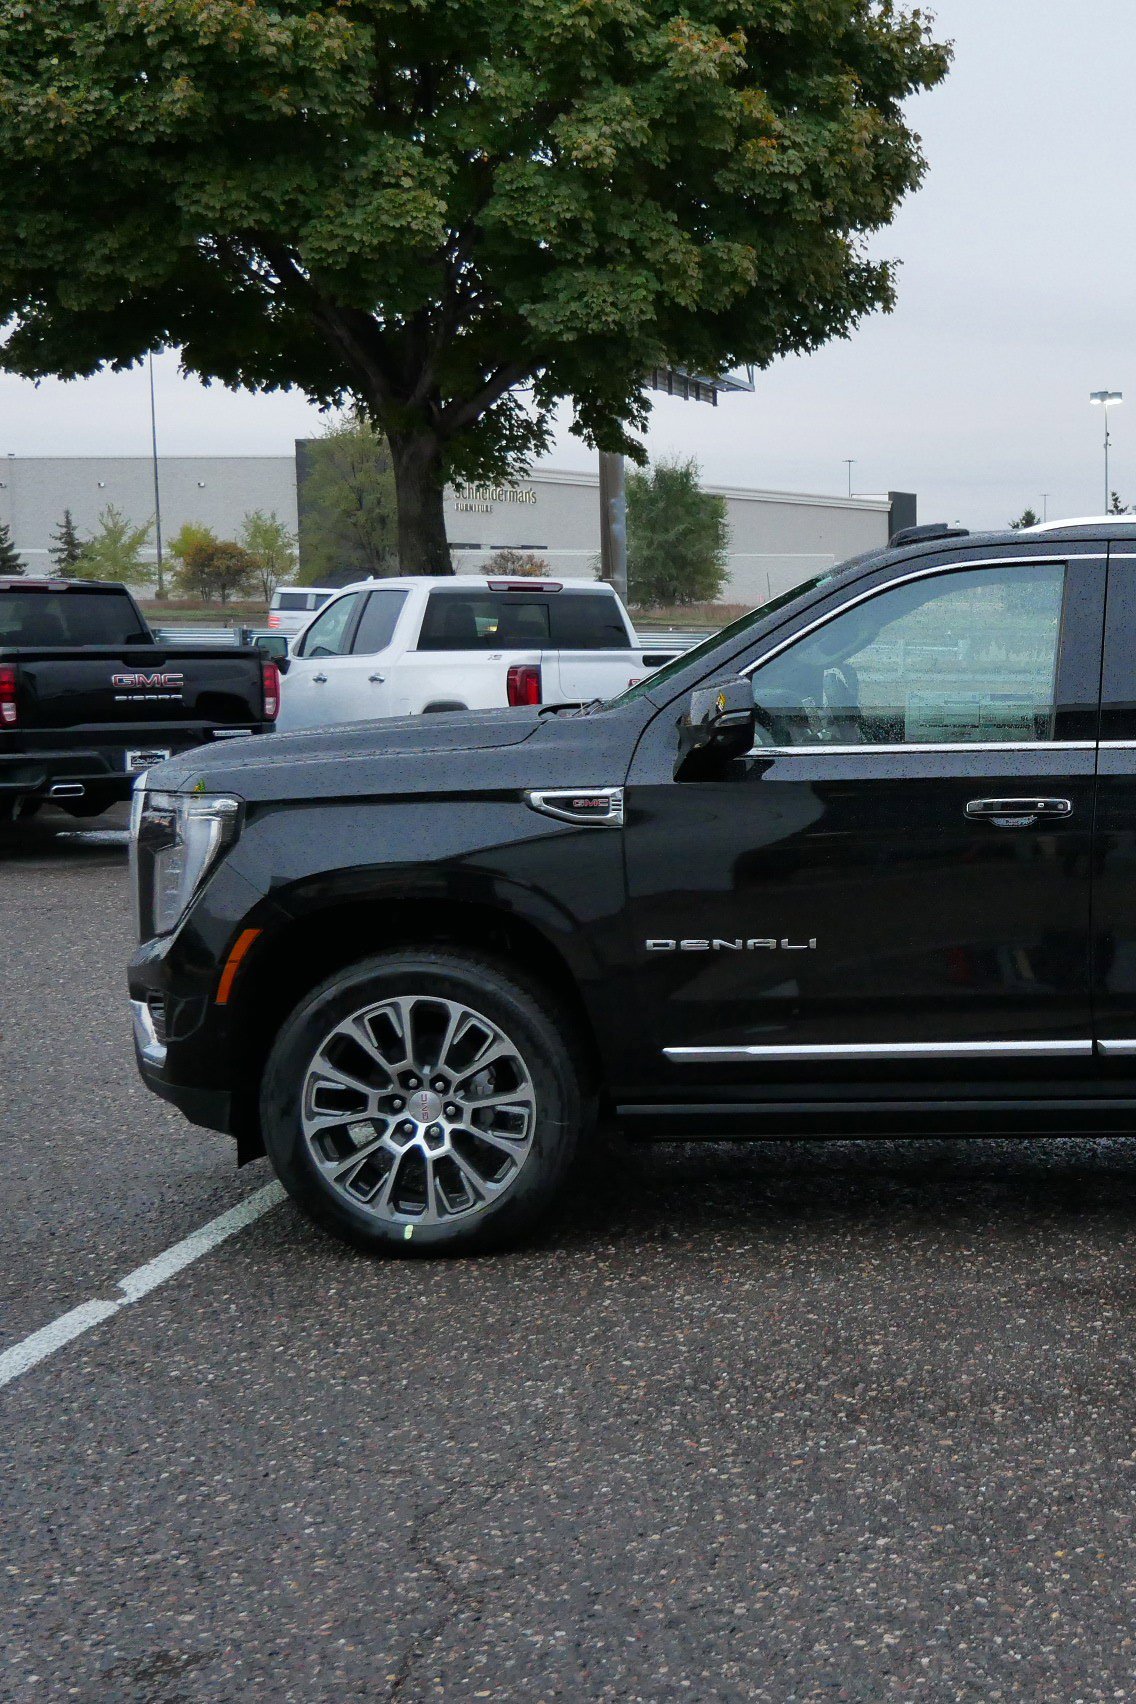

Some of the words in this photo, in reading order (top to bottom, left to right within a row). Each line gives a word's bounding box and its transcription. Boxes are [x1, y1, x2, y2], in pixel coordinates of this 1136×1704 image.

[454, 503, 494, 513] FURNITURE
[112, 673, 184, 688] GMC
[572, 798, 609, 808] GMC
[645, 937, 817, 951] DENALI
[420, 1093, 429, 1120] GMC
